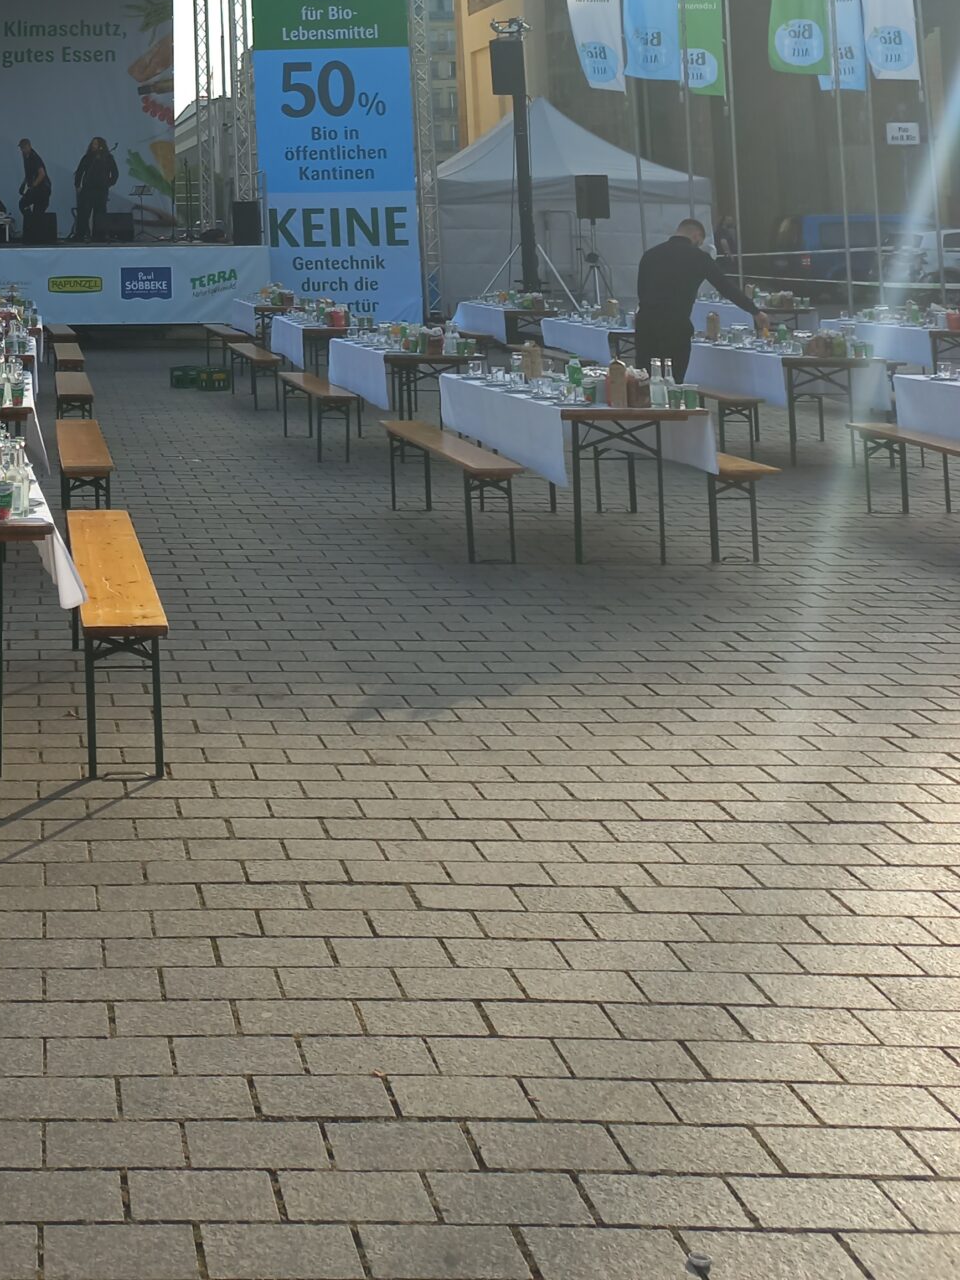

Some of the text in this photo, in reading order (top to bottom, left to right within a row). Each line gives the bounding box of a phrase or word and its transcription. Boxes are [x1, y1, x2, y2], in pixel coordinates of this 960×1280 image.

[301, 6, 359, 21] für Bio-
[3, 19, 127, 40] Klimaschutz,
[282, 24, 379, 41] Lebensmittel
[1, 47, 55, 68] gutes
[61, 45, 117, 64] Essen
[280, 60, 387, 118] 50%
[311, 126, 360, 141] Bio in
[284, 144, 388, 161] öffentlichen
[298, 165, 375, 181] Kantinen
[268, 206, 409, 248] KEINE
[292, 254, 386, 271] Gentechnik
[50, 279, 100, 290] RAPUNZEL
[138, 271, 155, 281] Paul
[190, 269, 238, 290] TERRA
[301, 276, 379, 292] durch die
[125, 280, 168, 290] SÖBBEKE
